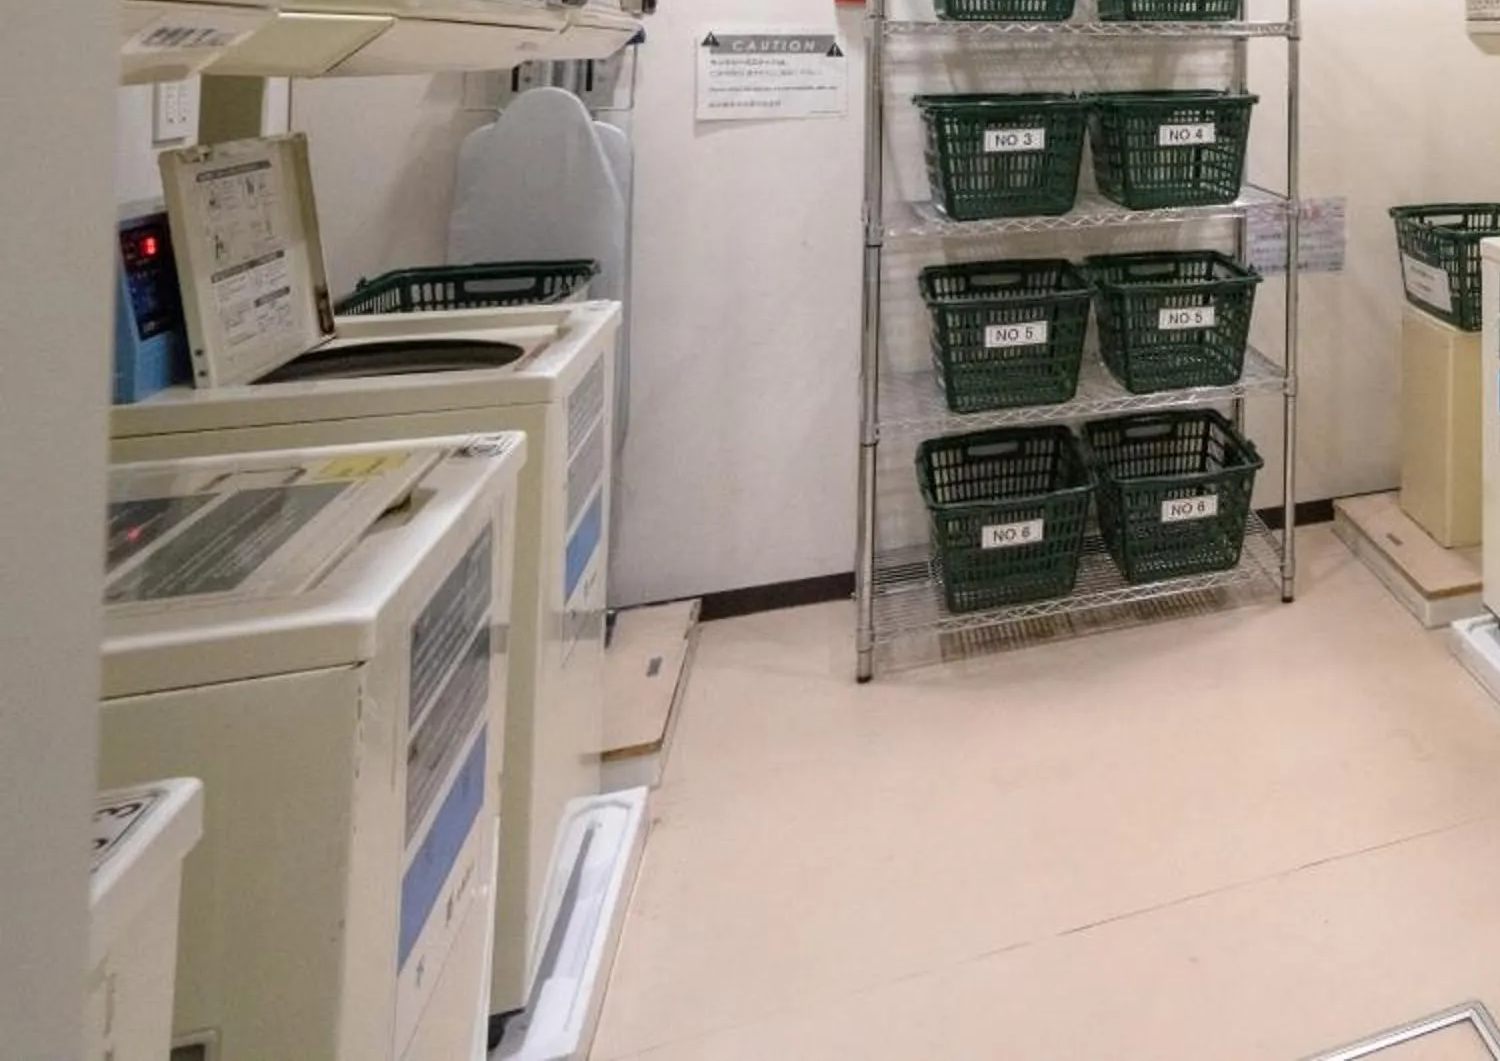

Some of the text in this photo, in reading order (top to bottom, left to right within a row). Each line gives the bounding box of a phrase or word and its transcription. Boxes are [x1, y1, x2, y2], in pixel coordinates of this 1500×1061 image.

[732, 39, 816, 51] CAUTION
[994, 133, 1033, 147] NO 3
[1168, 127, 1204, 141] NO 4
[1168, 312, 1190, 325] NO
[995, 326, 1034, 342] NO 5
[1171, 503, 1193, 516] NO
[993, 529, 1017, 543] NO
